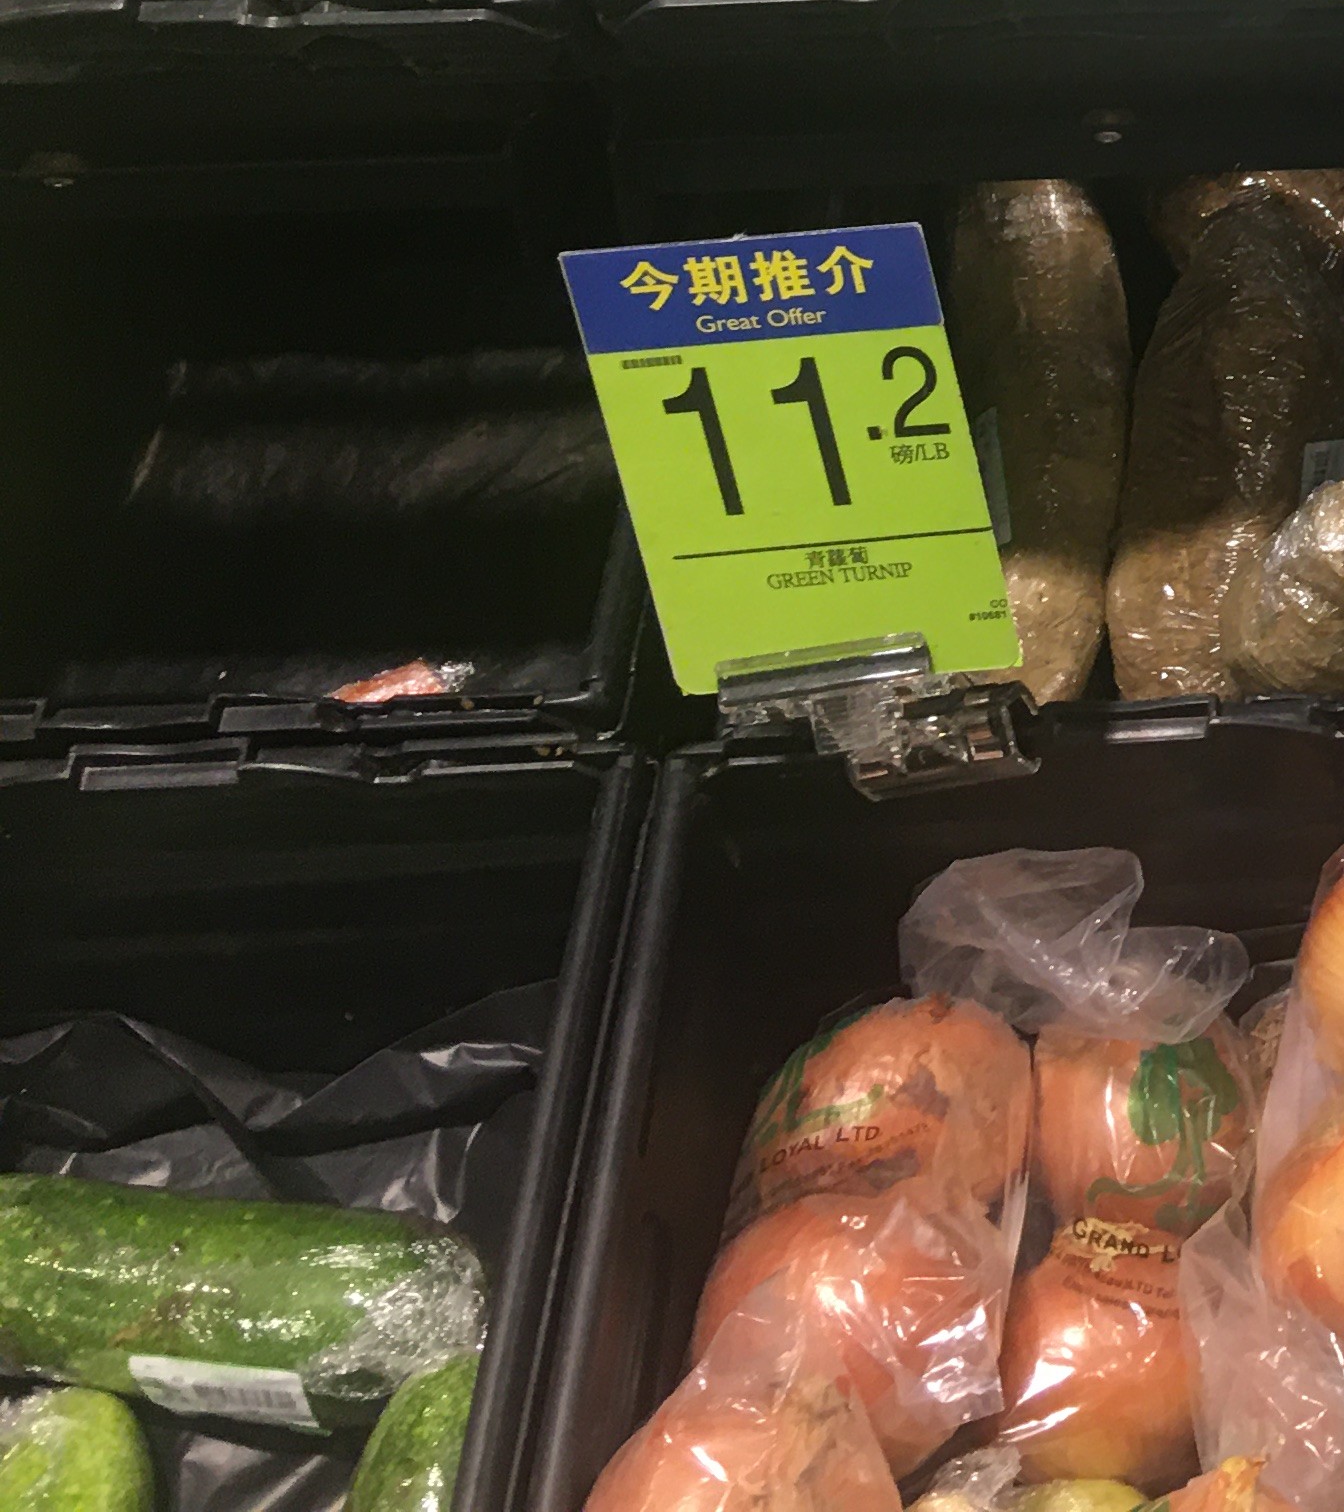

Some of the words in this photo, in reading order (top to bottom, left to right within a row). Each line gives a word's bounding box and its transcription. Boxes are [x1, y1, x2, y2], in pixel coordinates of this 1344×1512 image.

[620, 245, 875, 311] 今期推介
[696, 312, 762, 334] Great
[767, 307, 827, 328] Offer
[662, 346, 952, 516] 11.2
[767, 569, 835, 590] GREEN
[838, 561, 913, 584] TURNIP
[836, 1125, 881, 1143] LTD
